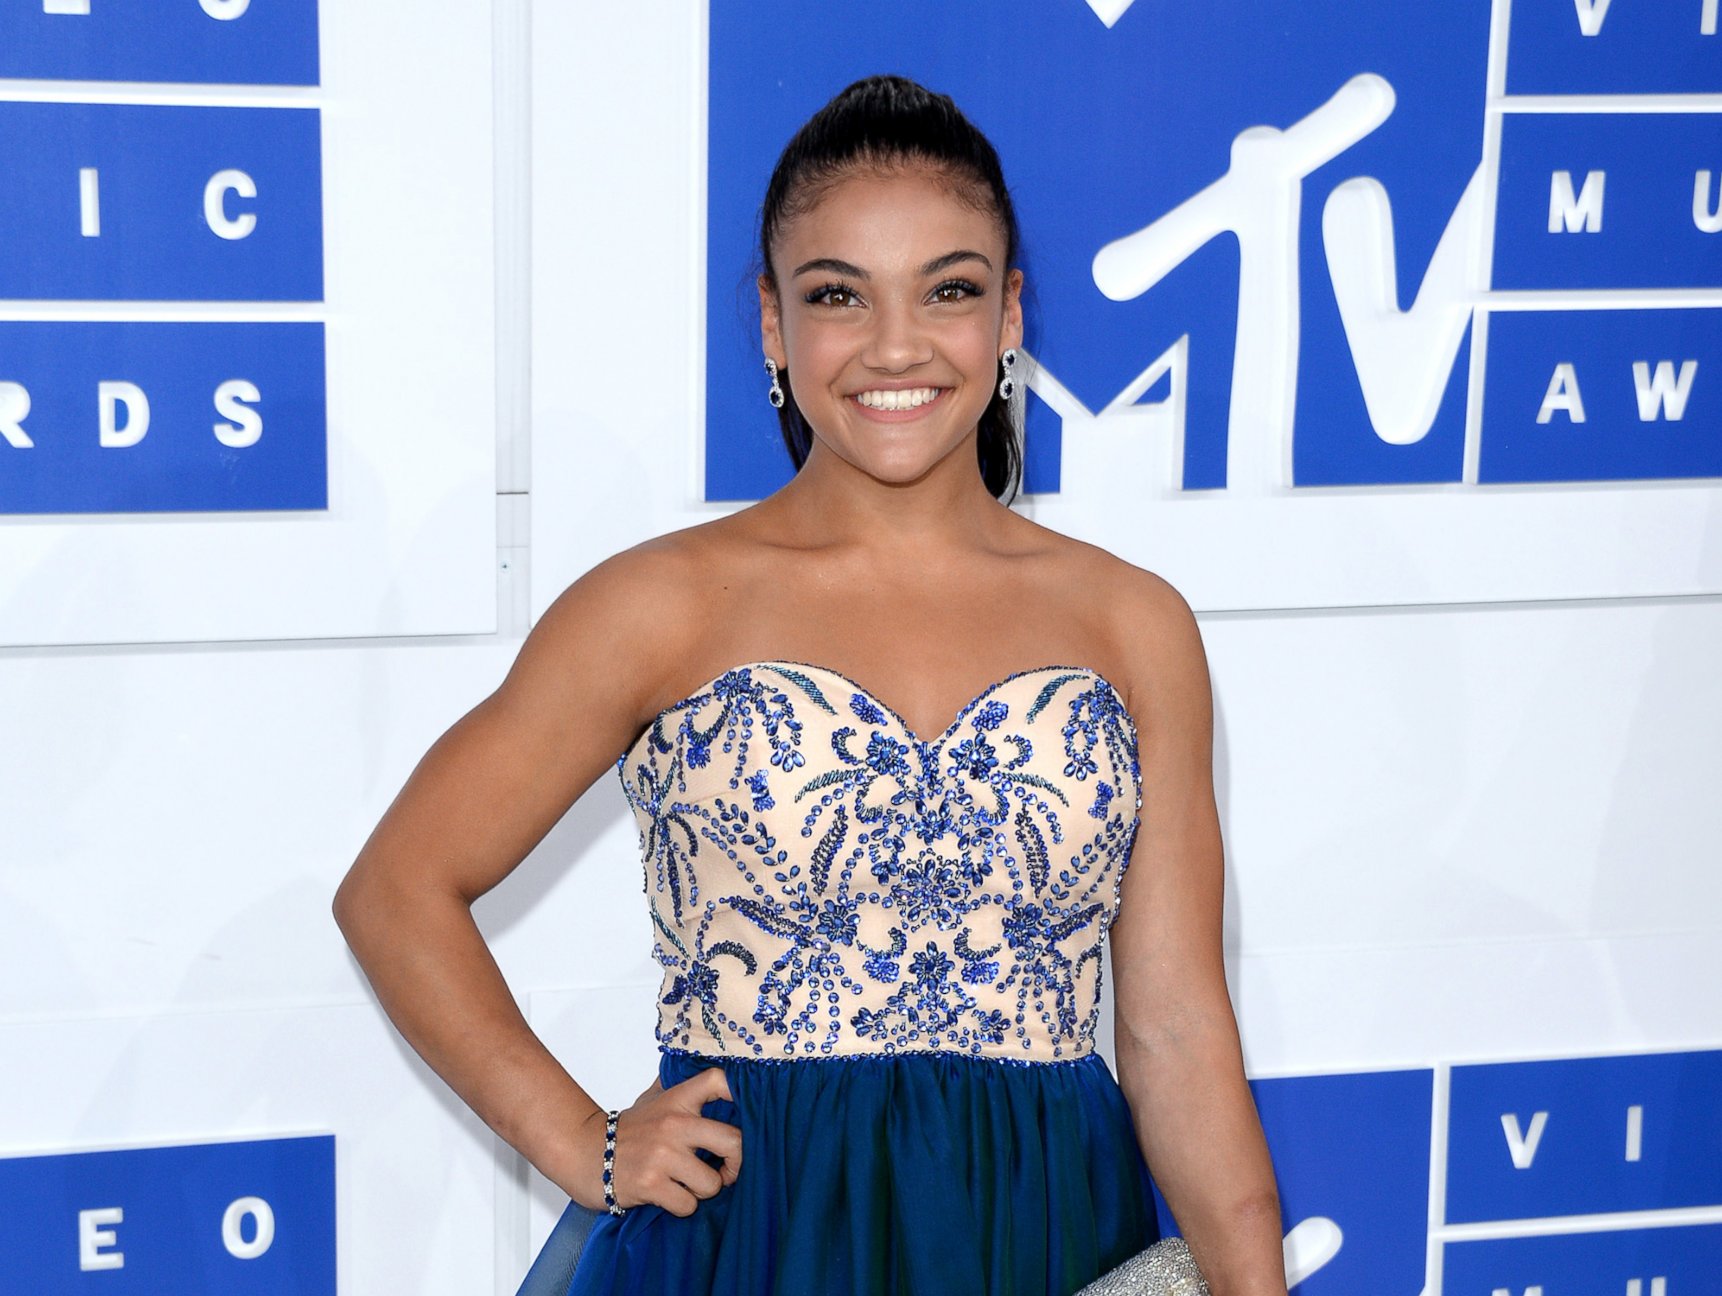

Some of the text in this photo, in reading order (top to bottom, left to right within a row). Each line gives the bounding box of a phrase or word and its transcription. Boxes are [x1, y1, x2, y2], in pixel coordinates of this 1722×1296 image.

[80, 168, 257, 240] IC
[1548, 170, 1722, 233] MU
[1536, 361, 1698, 424] AW
[1500, 1105, 1643, 1169] VI
[79, 1196, 275, 1271] EO
